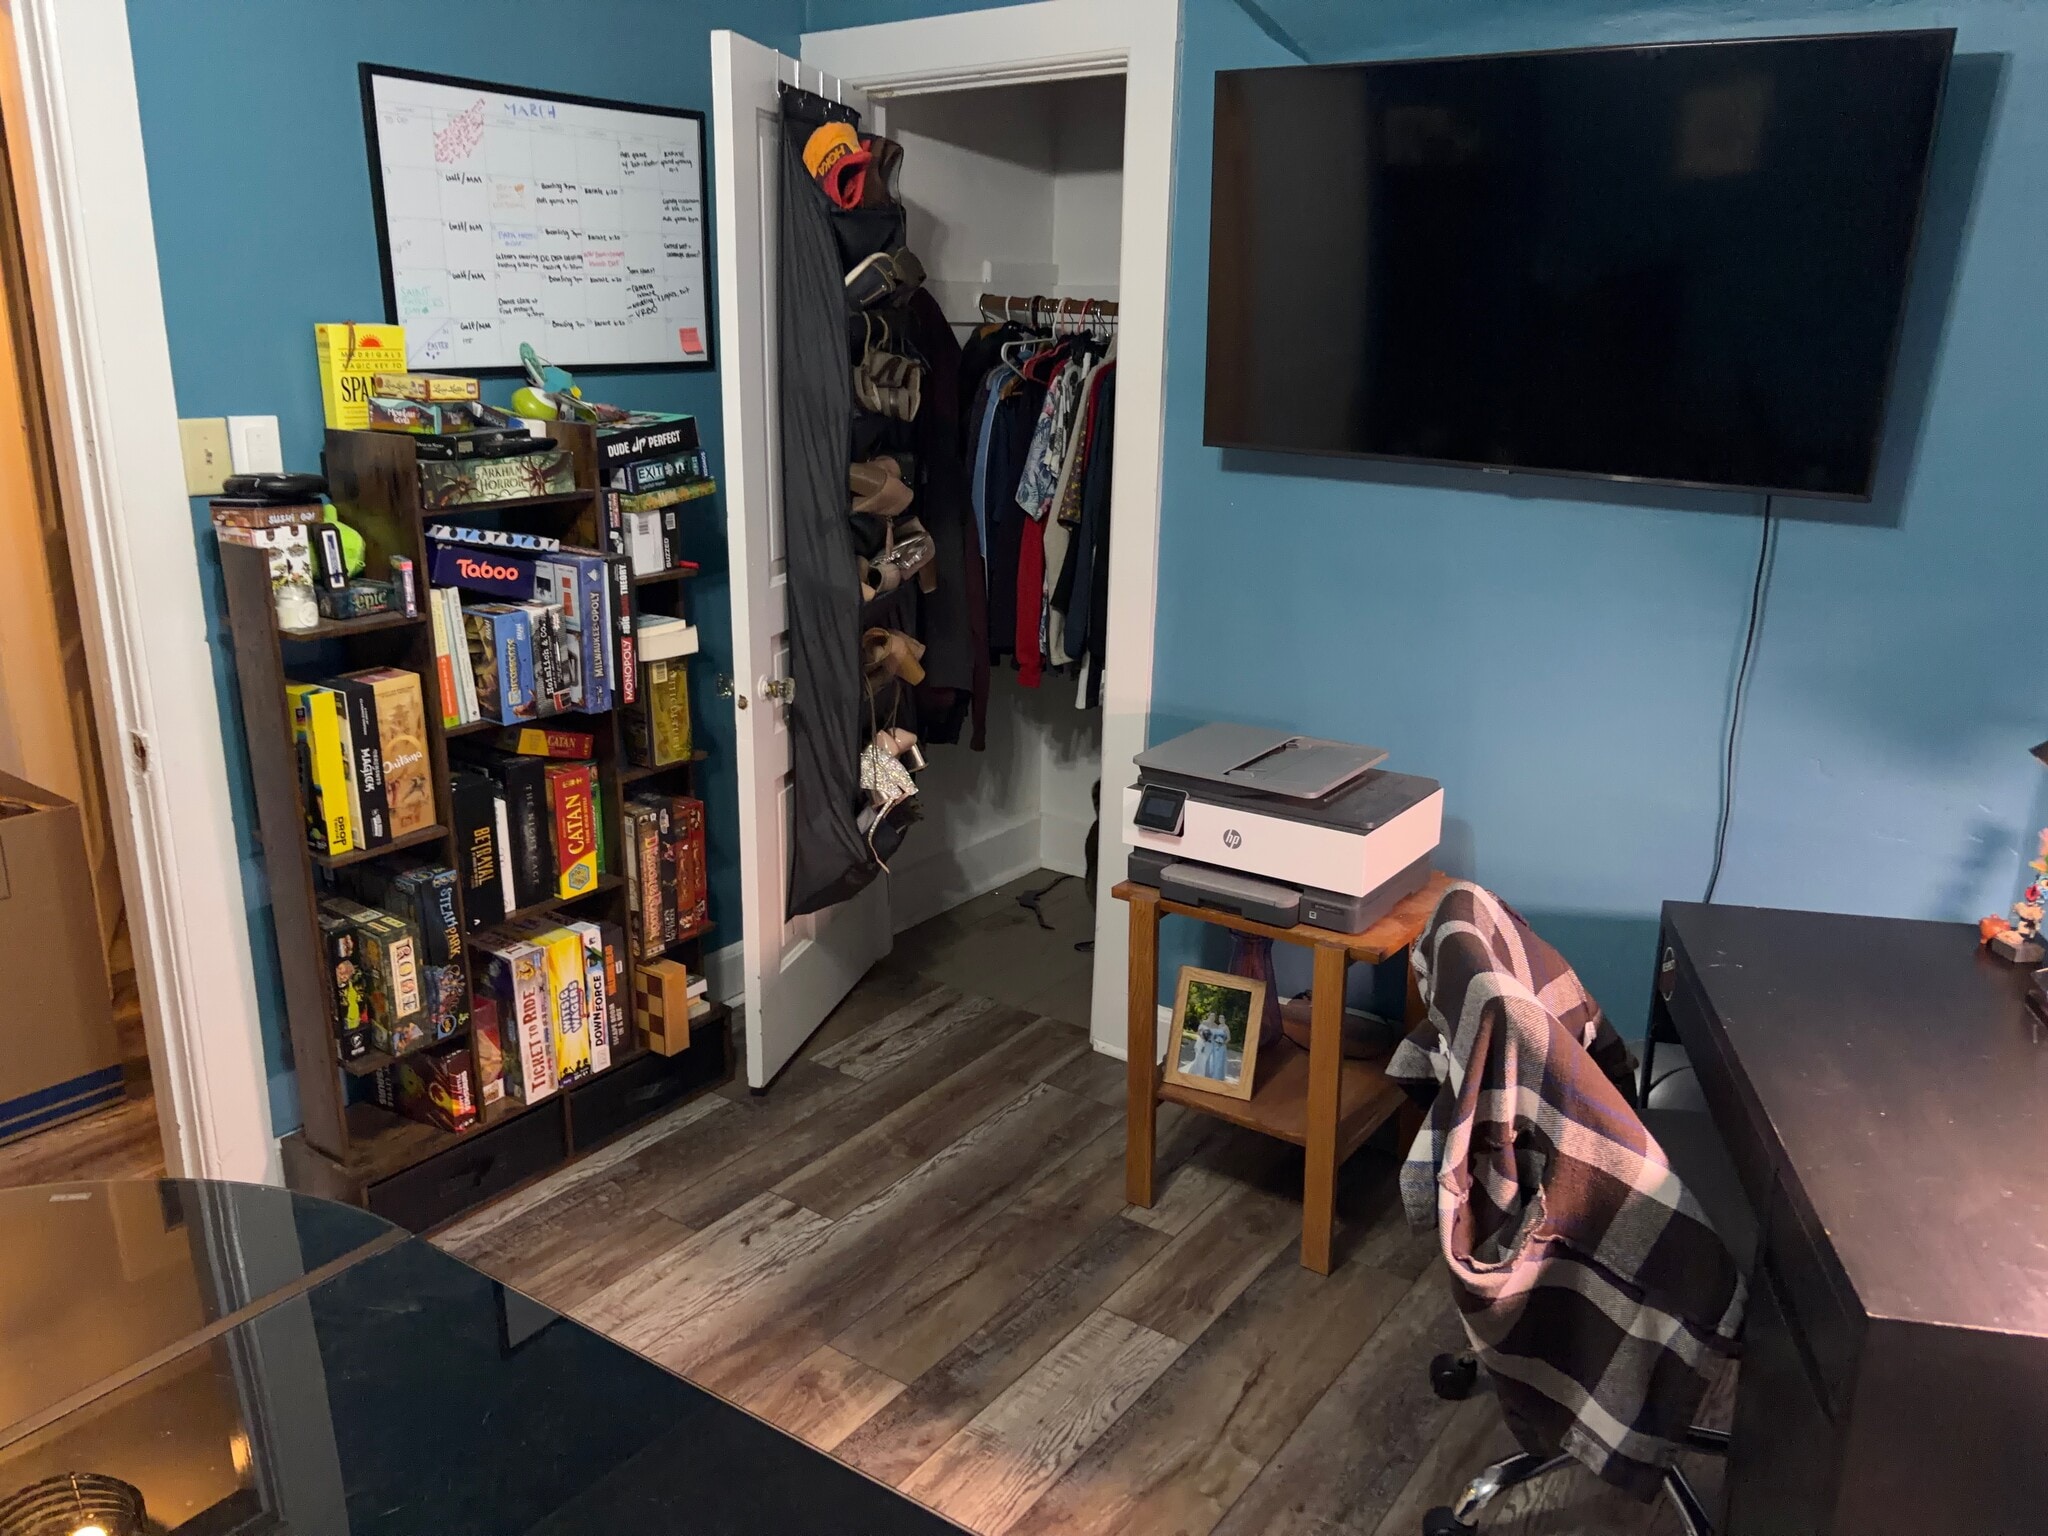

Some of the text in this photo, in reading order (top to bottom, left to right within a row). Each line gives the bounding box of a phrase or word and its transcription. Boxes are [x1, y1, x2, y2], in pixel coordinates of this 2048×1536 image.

[504, 102, 557, 119] MARCH
[816, 144, 848, 177] HOKA
[608, 442, 630, 458] DUDE
[648, 431, 682, 448] PERFECT
[481, 478, 526, 496] HORROR
[482, 465, 526, 482] ARKHAM
[638, 465, 663, 480] EXIT
[269, 514, 296, 525] SUSHI
[663, 537, 672, 568] BUZZED
[456, 558, 520, 582] Taboo
[619, 564, 628, 595] THEORY
[356, 591, 388, 610] epic
[541, 638, 549, 647] &
[622, 639, 633, 701] MONOPOLY
[548, 735, 577, 749] CATAN
[360, 748, 375, 792] MAGICK
[382, 751, 423, 774] Onitama
[333, 816, 347, 847] DROP
[524, 783, 540, 885] THE NIGHT CAGE
[566, 794, 585, 855] CATAN
[1225, 829, 1241, 848] hp
[470, 826, 495, 884] BETRAYAL
[396, 940, 418, 1011] ROOT
[560, 998, 572, 1034] WITS
[569, 981, 582, 1032] WAGERS
[523, 987, 546, 1093] TICKET TO RIDE
[376, 1069, 387, 1105] SAURS
